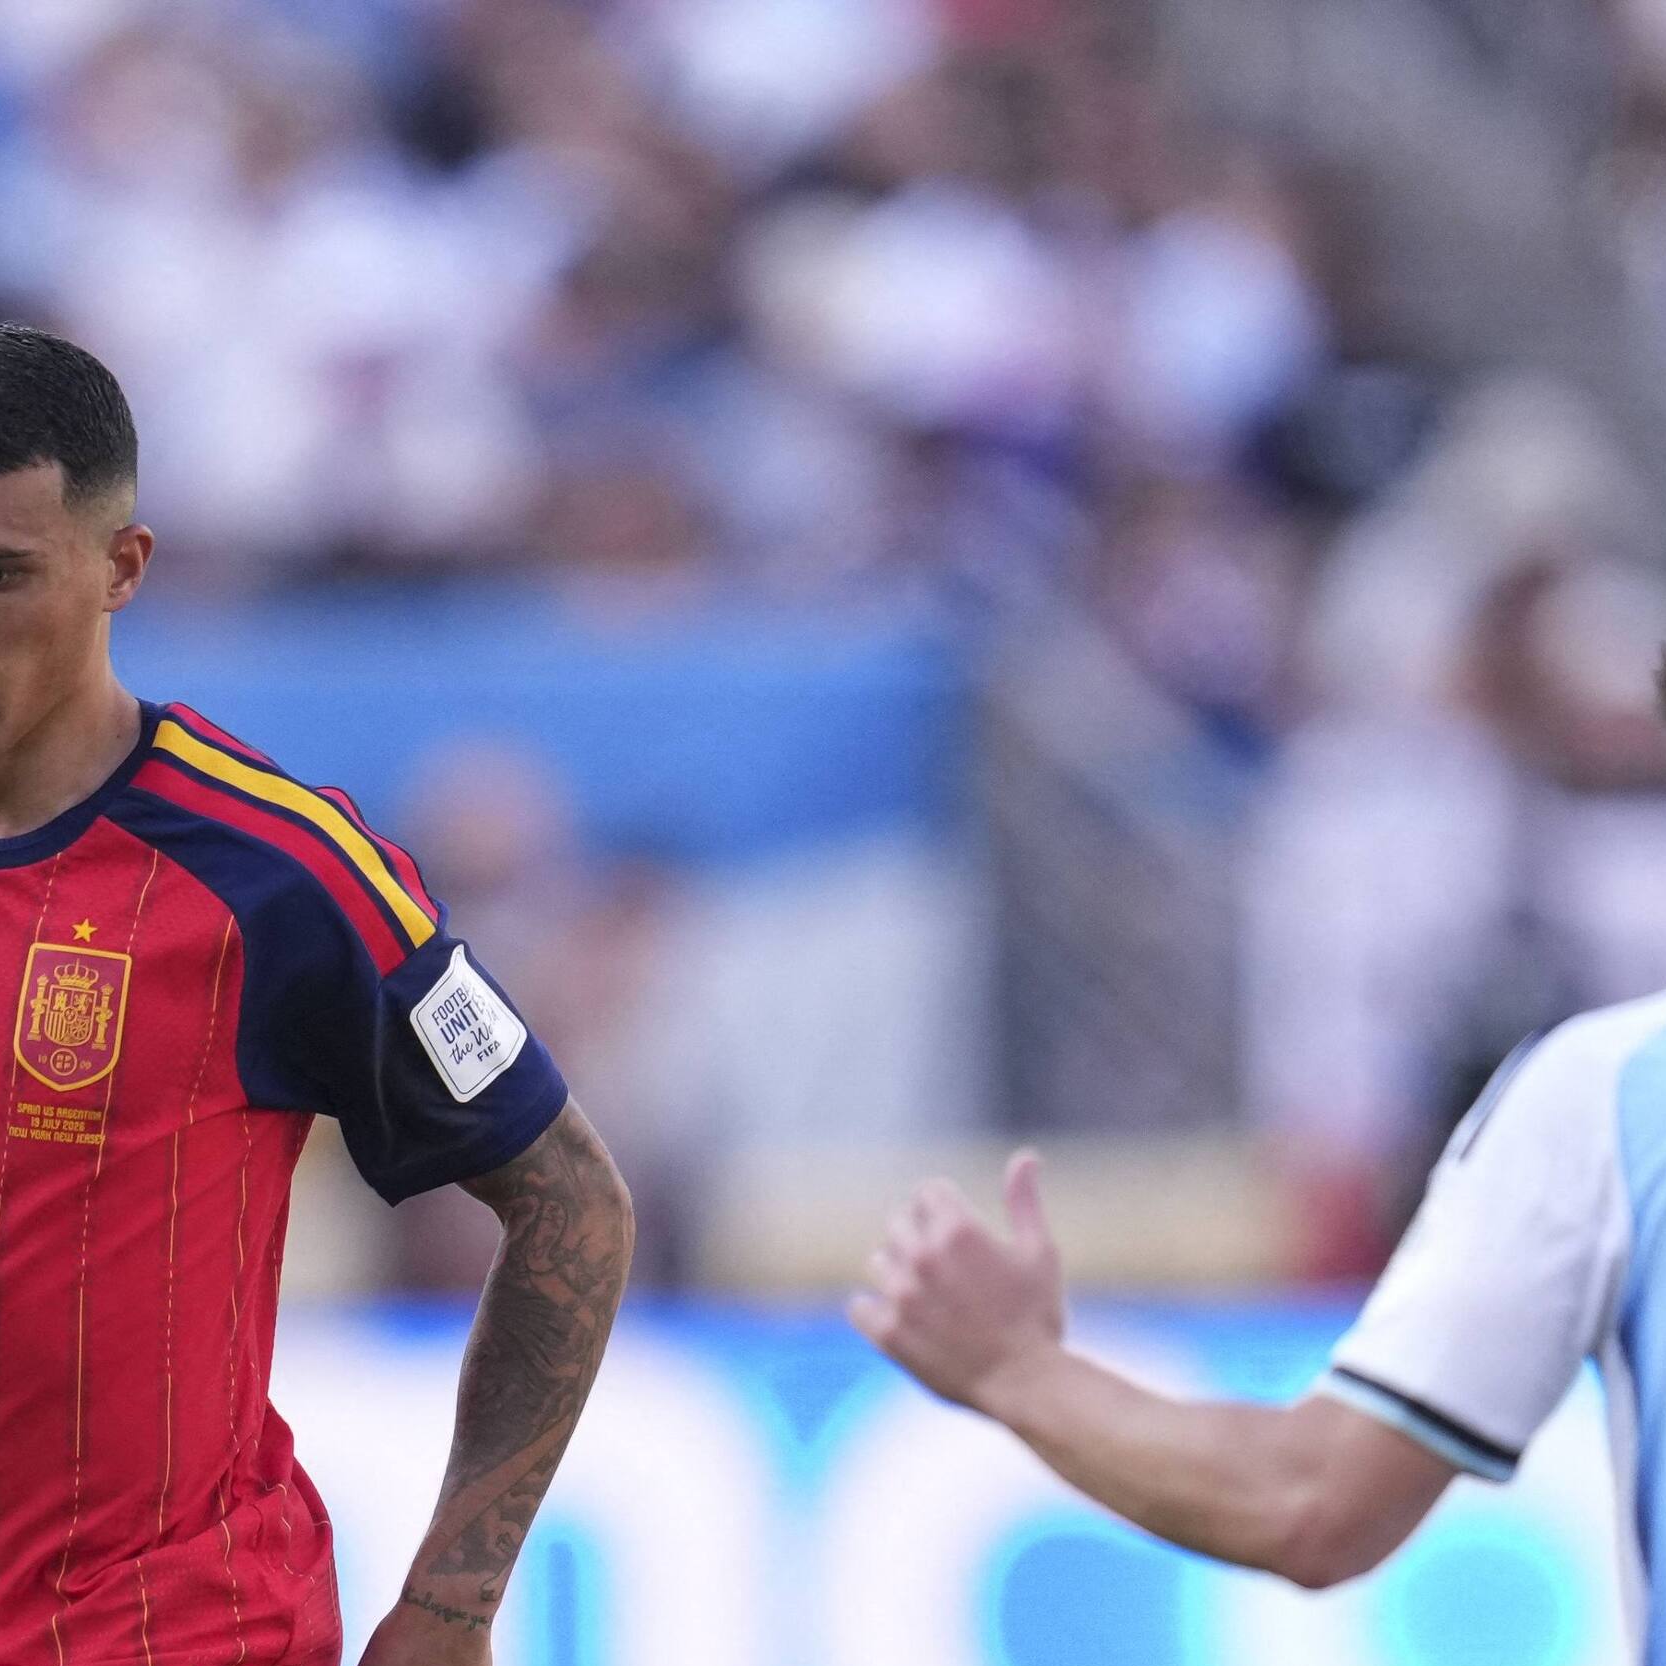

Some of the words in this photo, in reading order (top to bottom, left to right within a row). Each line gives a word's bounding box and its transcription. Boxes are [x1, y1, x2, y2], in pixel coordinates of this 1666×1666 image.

[450, 1043, 473, 1065] the
[477, 1040, 501, 1062] FIFA
[17, 1102, 41, 1115] SPAIN
[56, 1107, 102, 1121] ARGENTINA
[42, 1118, 61, 1129] JULY
[62, 1120, 85, 1132] 2026
[8, 1126, 28, 1138] NEW
[30, 1129, 51, 1141] YORK
[53, 1131, 74, 1143] NEW
[75, 1133, 106, 1145] JERSEY
